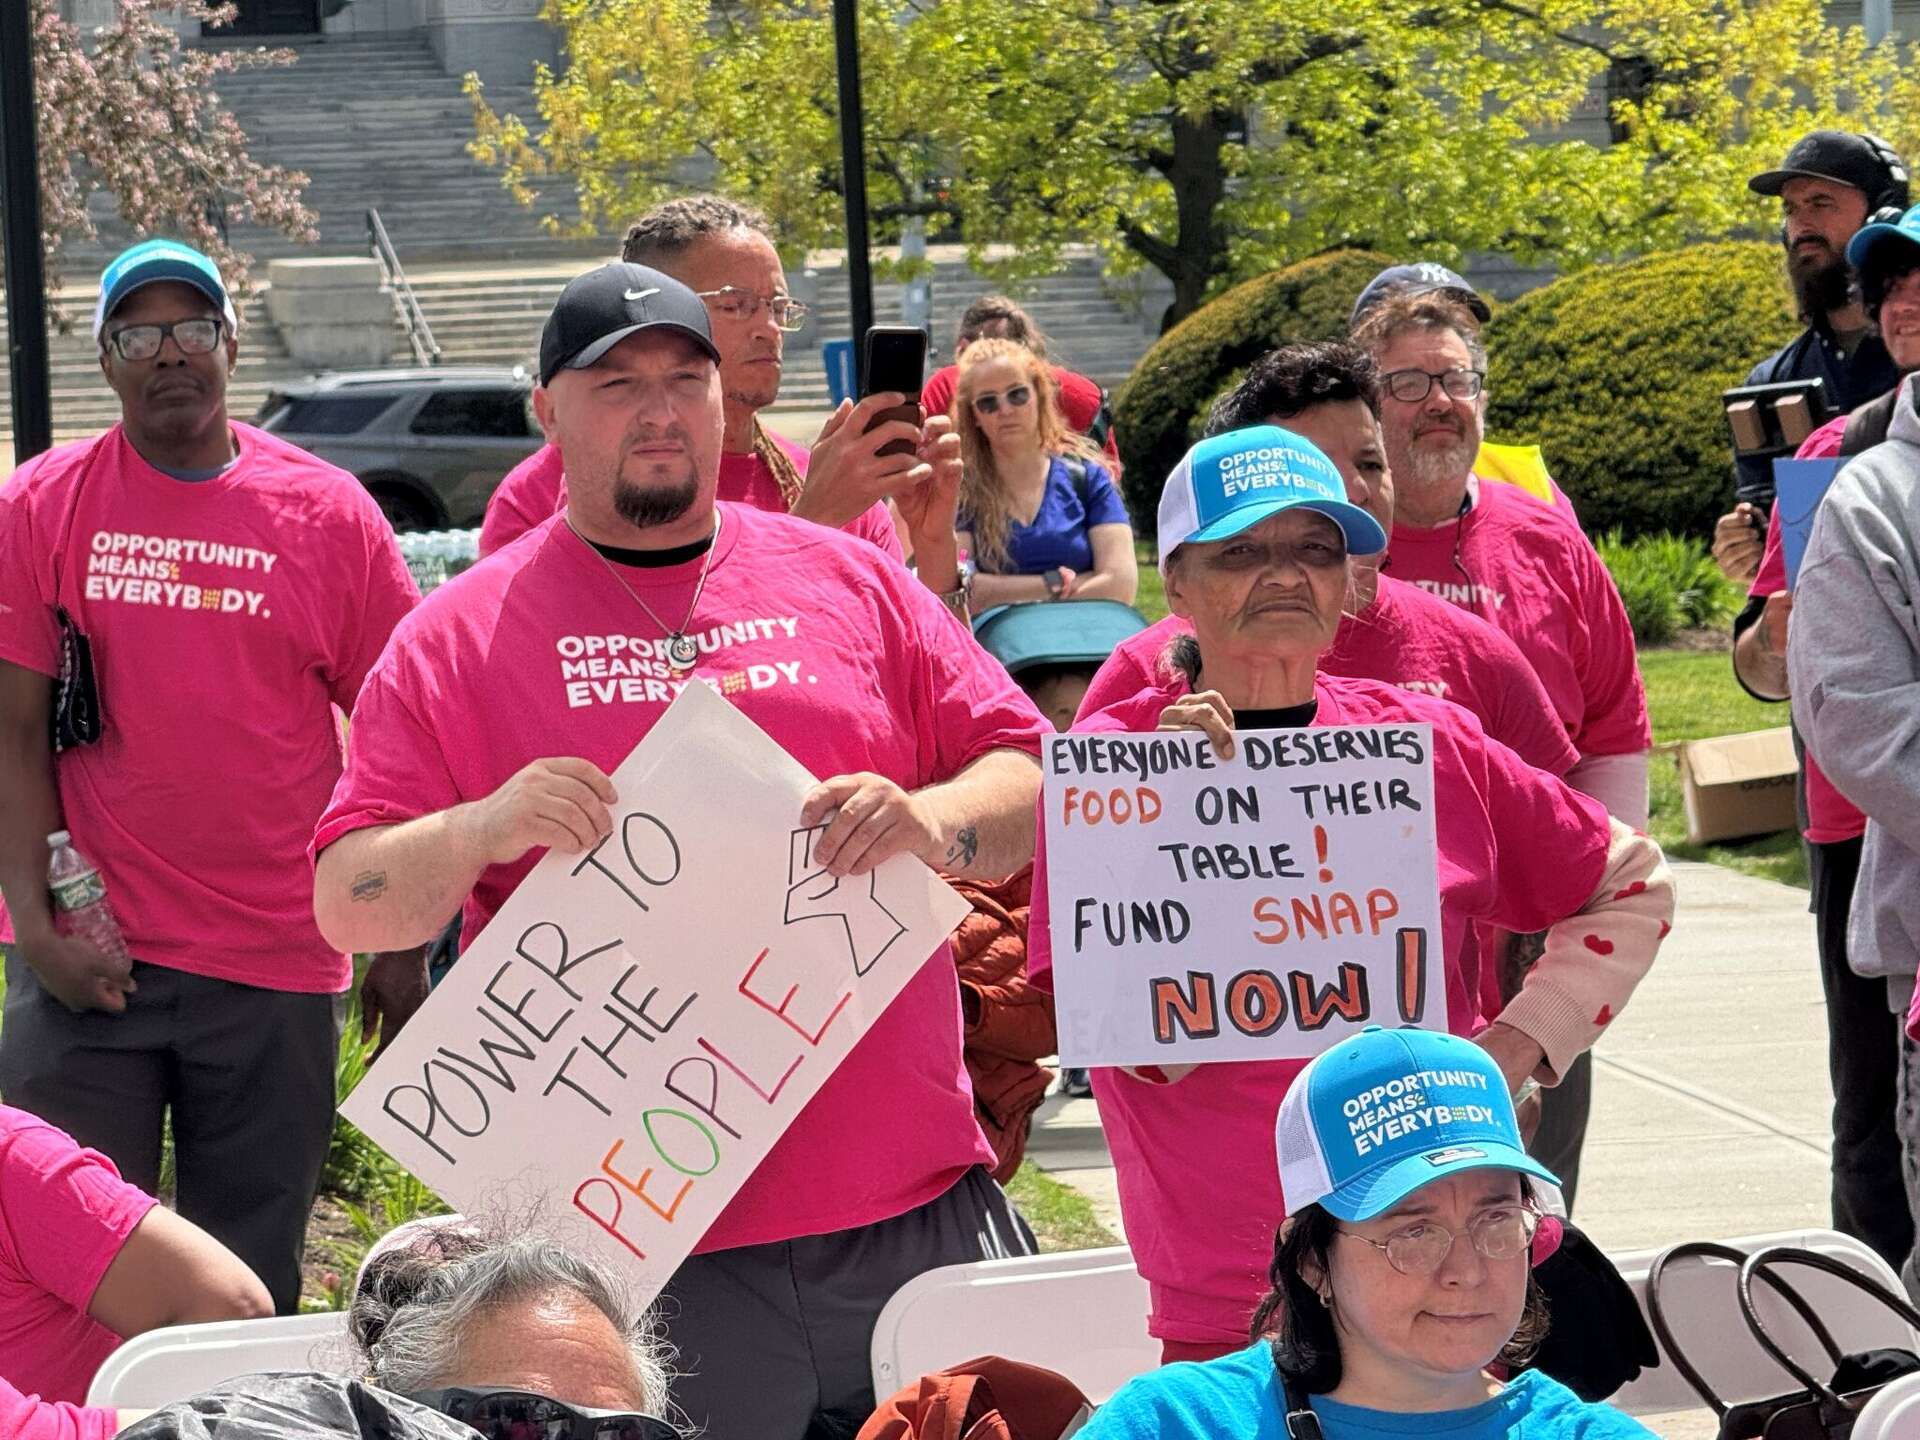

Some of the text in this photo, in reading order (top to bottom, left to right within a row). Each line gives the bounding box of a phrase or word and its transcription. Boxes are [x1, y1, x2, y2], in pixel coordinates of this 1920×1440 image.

[1219, 447, 1335, 480] OPPORTUNITY
[1221, 461, 1280, 482] MEANS
[88, 553, 170, 581] MEANS
[91, 530, 277, 574] OPPORTUNITY
[560, 658, 671, 680] MEANS
[1051, 728, 1425, 782] EVERYONE DESERVES
[1063, 777, 1423, 827] FOOD ON THEIR
[1074, 888, 1400, 953] FUND SNAP
[382, 811, 681, 1166] POWER TO
[542, 963, 700, 1117] THE
[572, 946, 854, 1261] PEOPLE
[1343, 1070, 1488, 1118] OPPORTUNITY
[1349, 1096, 1418, 1137] MEANS
